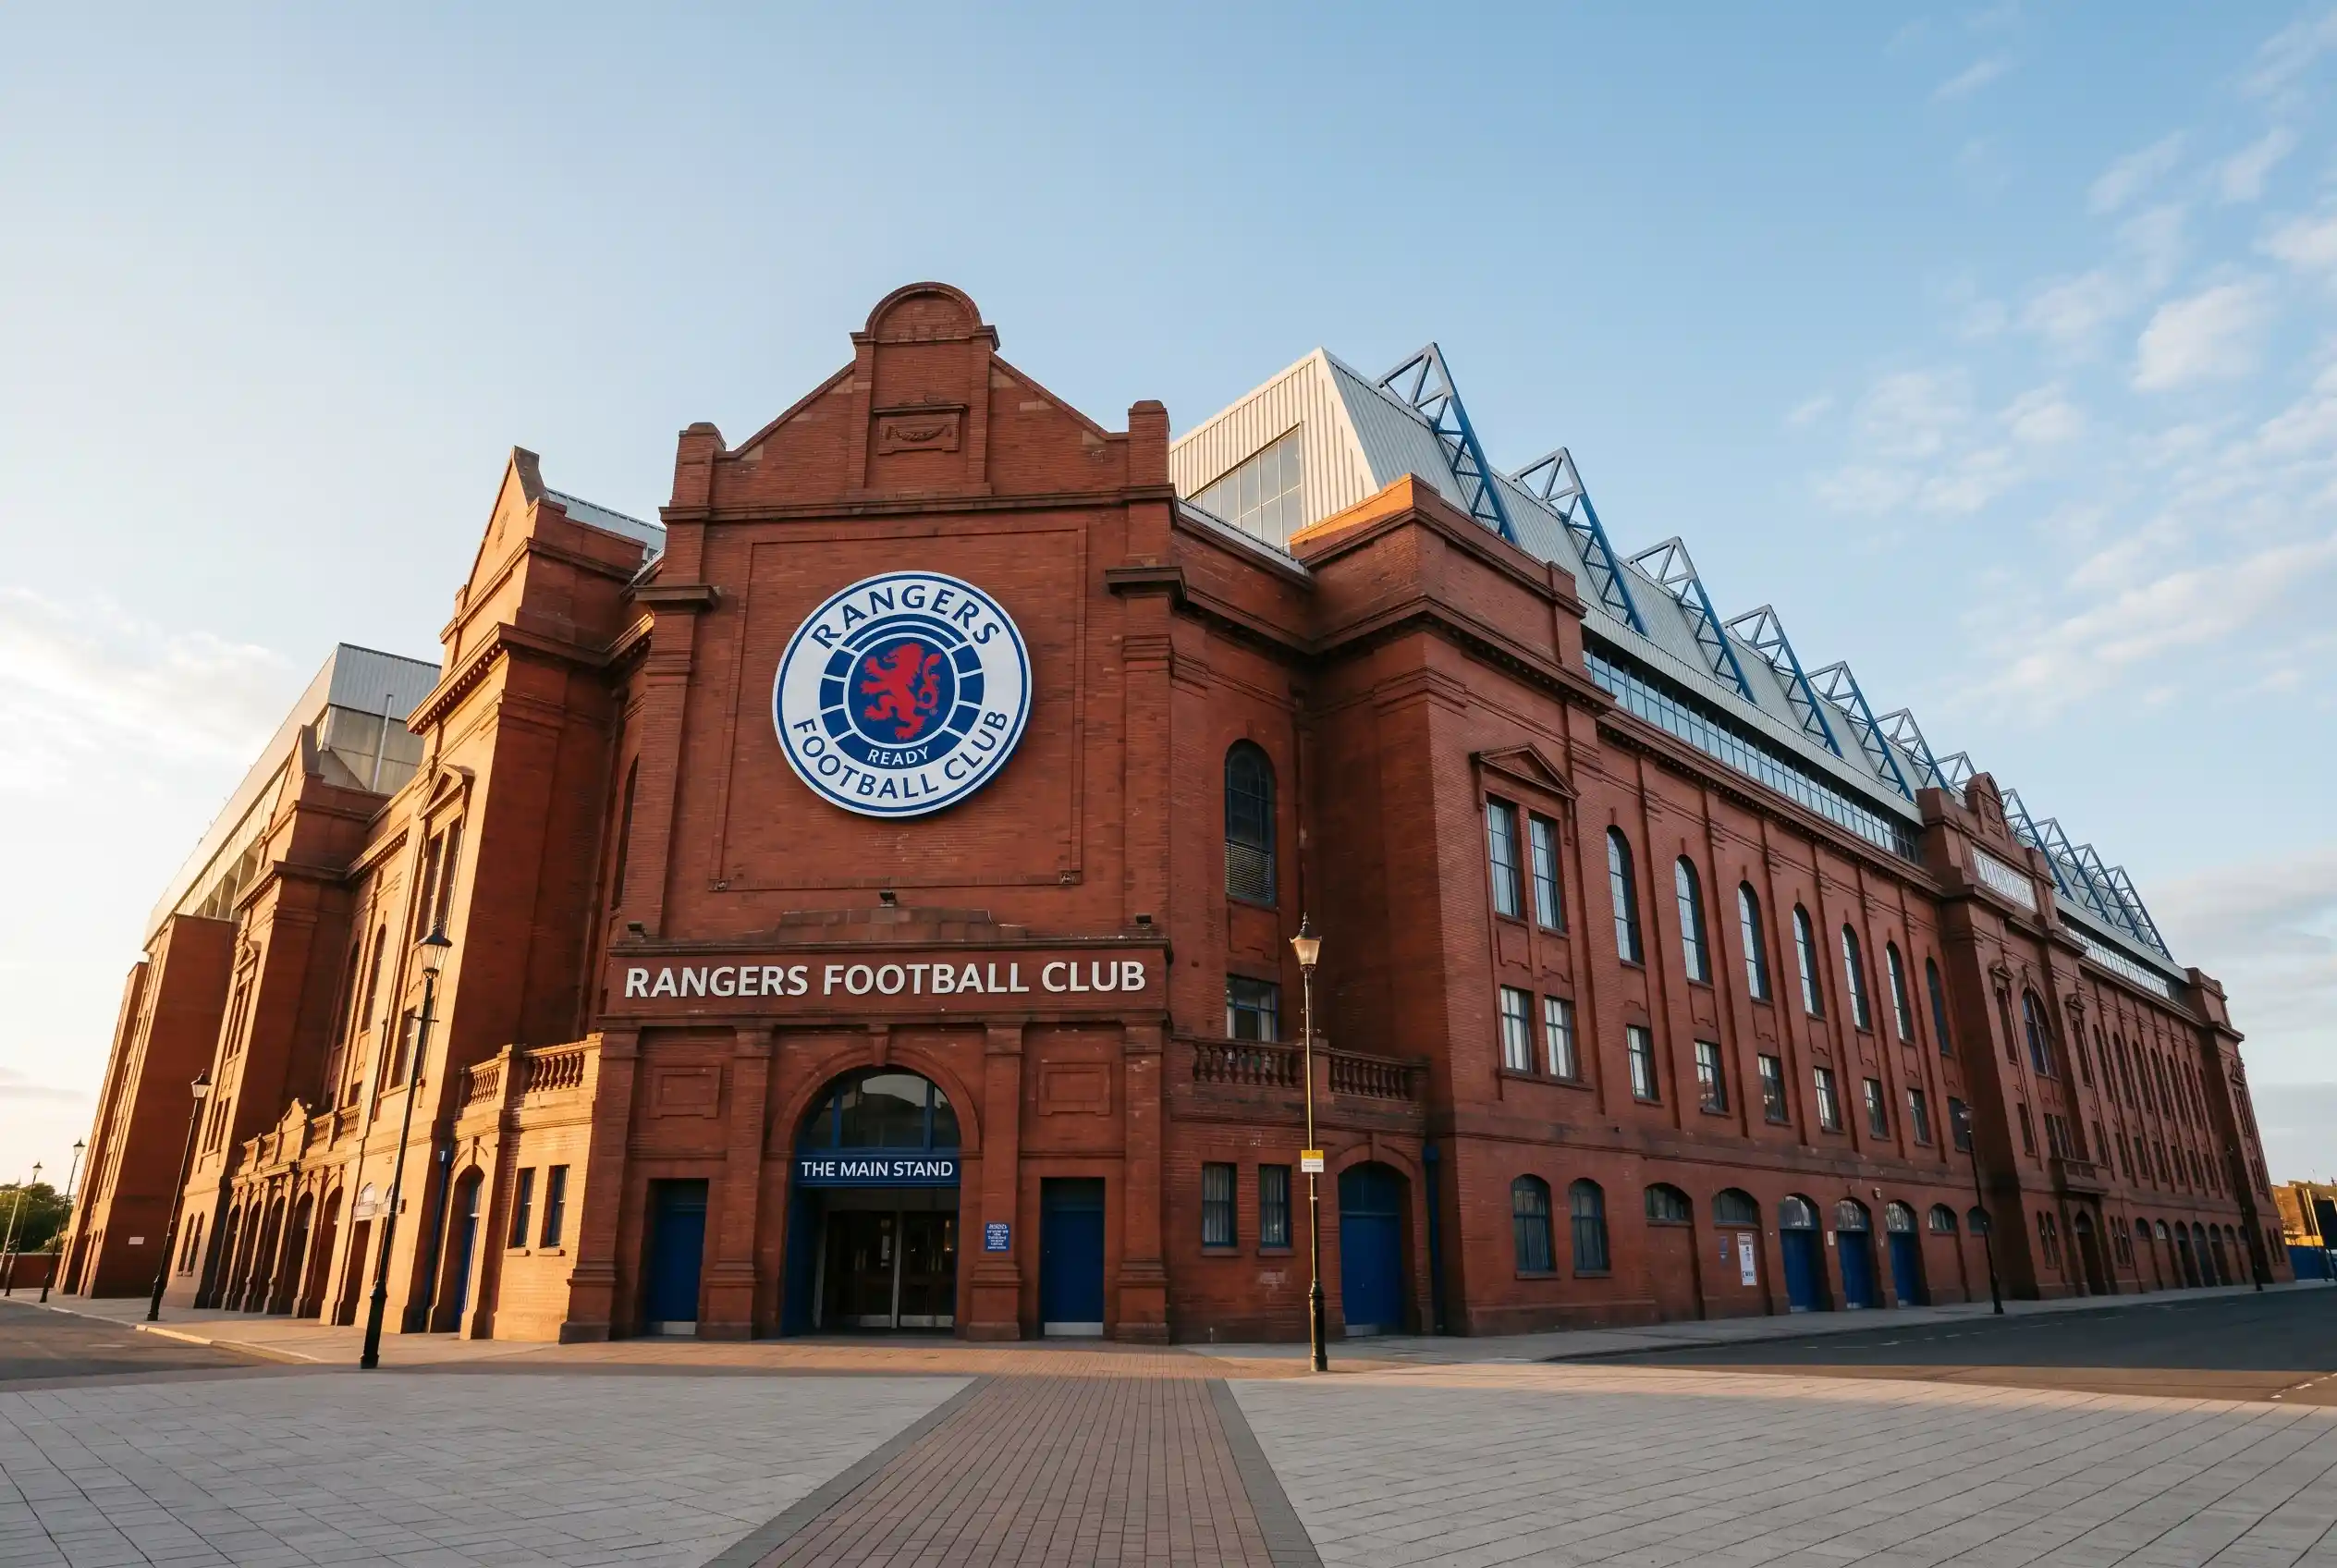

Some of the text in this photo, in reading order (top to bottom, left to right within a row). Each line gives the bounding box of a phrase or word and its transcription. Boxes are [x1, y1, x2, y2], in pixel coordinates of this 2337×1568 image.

[811, 584, 1000, 650] RANGERS
[793, 710, 1008, 799] FOOTBALL CLUB
[866, 746, 929, 766] READY
[624, 961, 1146, 998] RANGERS FOOTBALL CLUB
[801, 1161, 953, 1177] THE MAIN STAND
